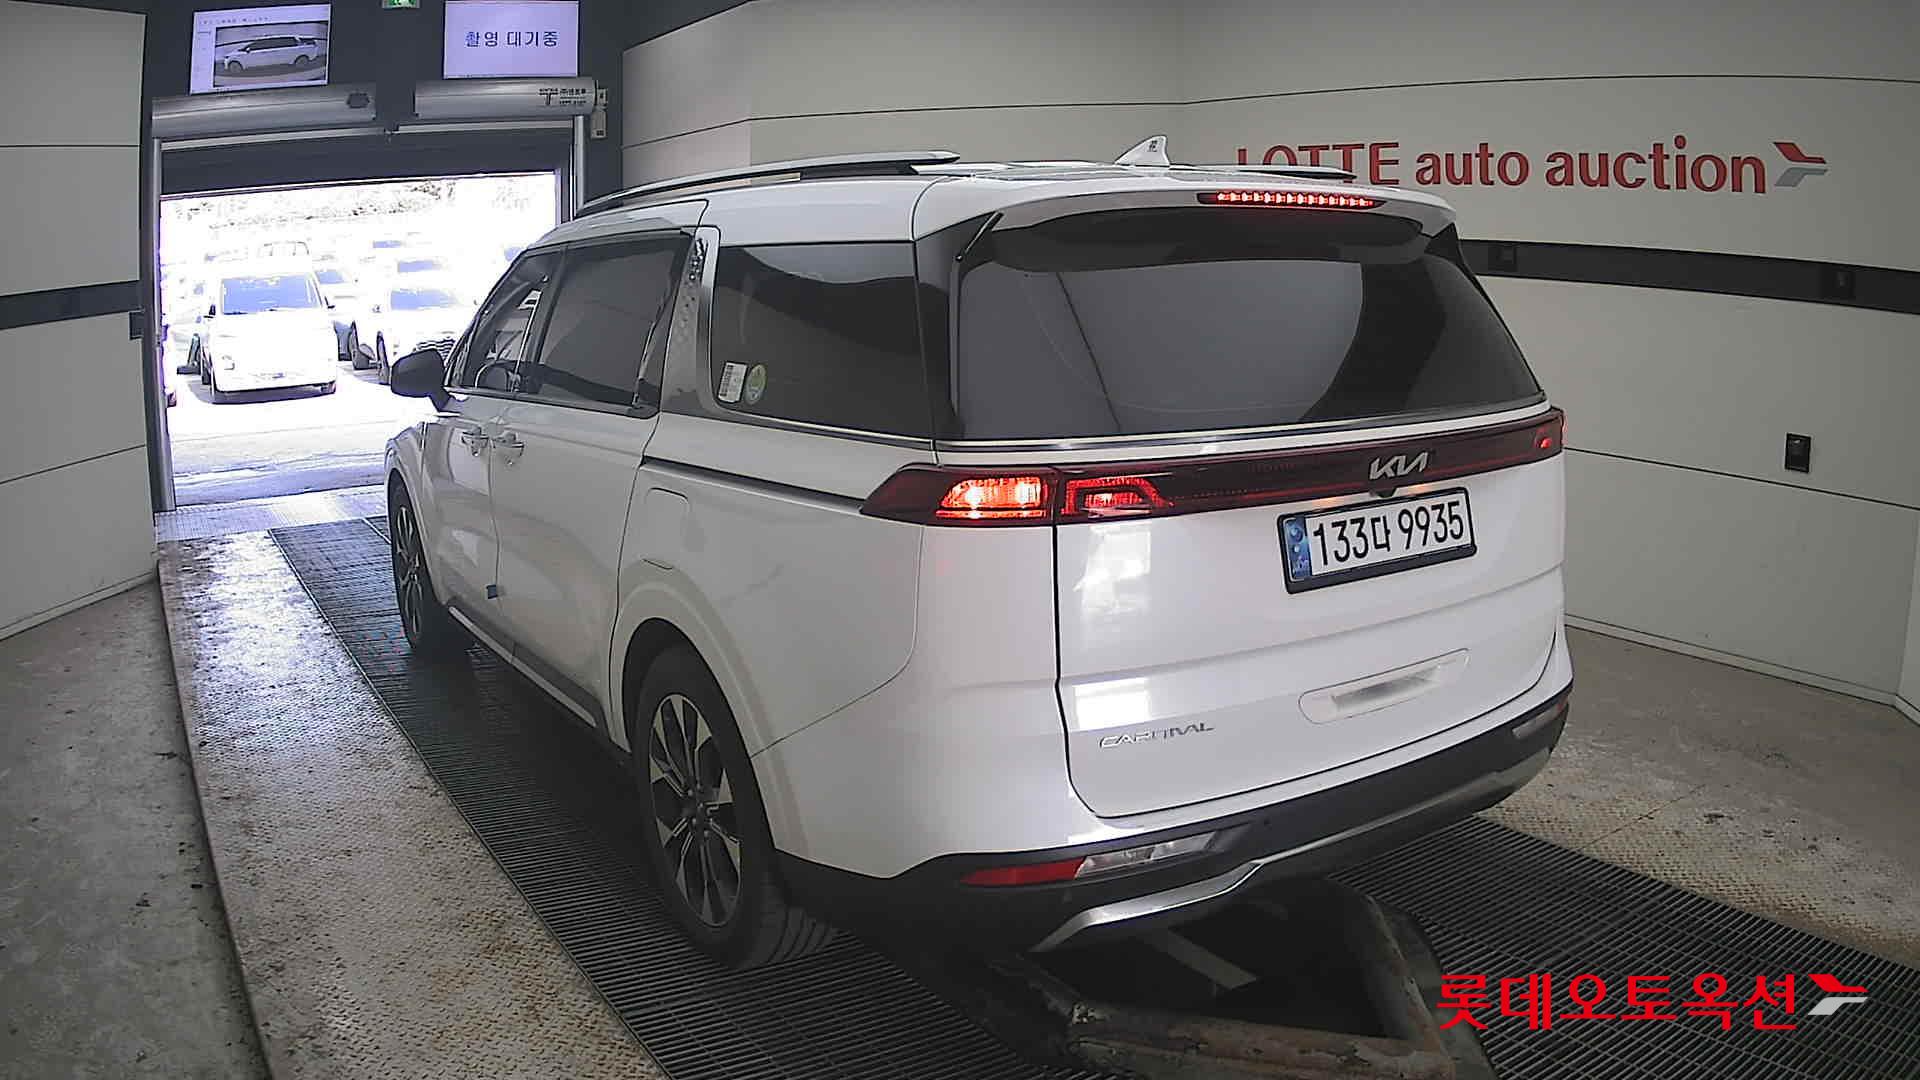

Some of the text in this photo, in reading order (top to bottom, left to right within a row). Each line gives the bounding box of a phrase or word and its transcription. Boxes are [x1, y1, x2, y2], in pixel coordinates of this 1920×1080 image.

[507, 30, 559, 48] 대기중
[1415, 142, 1530, 187] auto
[1545, 135, 1766, 194] auction
[1368, 452, 1428, 480] KIA
[1313, 500, 1465, 567] 133다 9935
